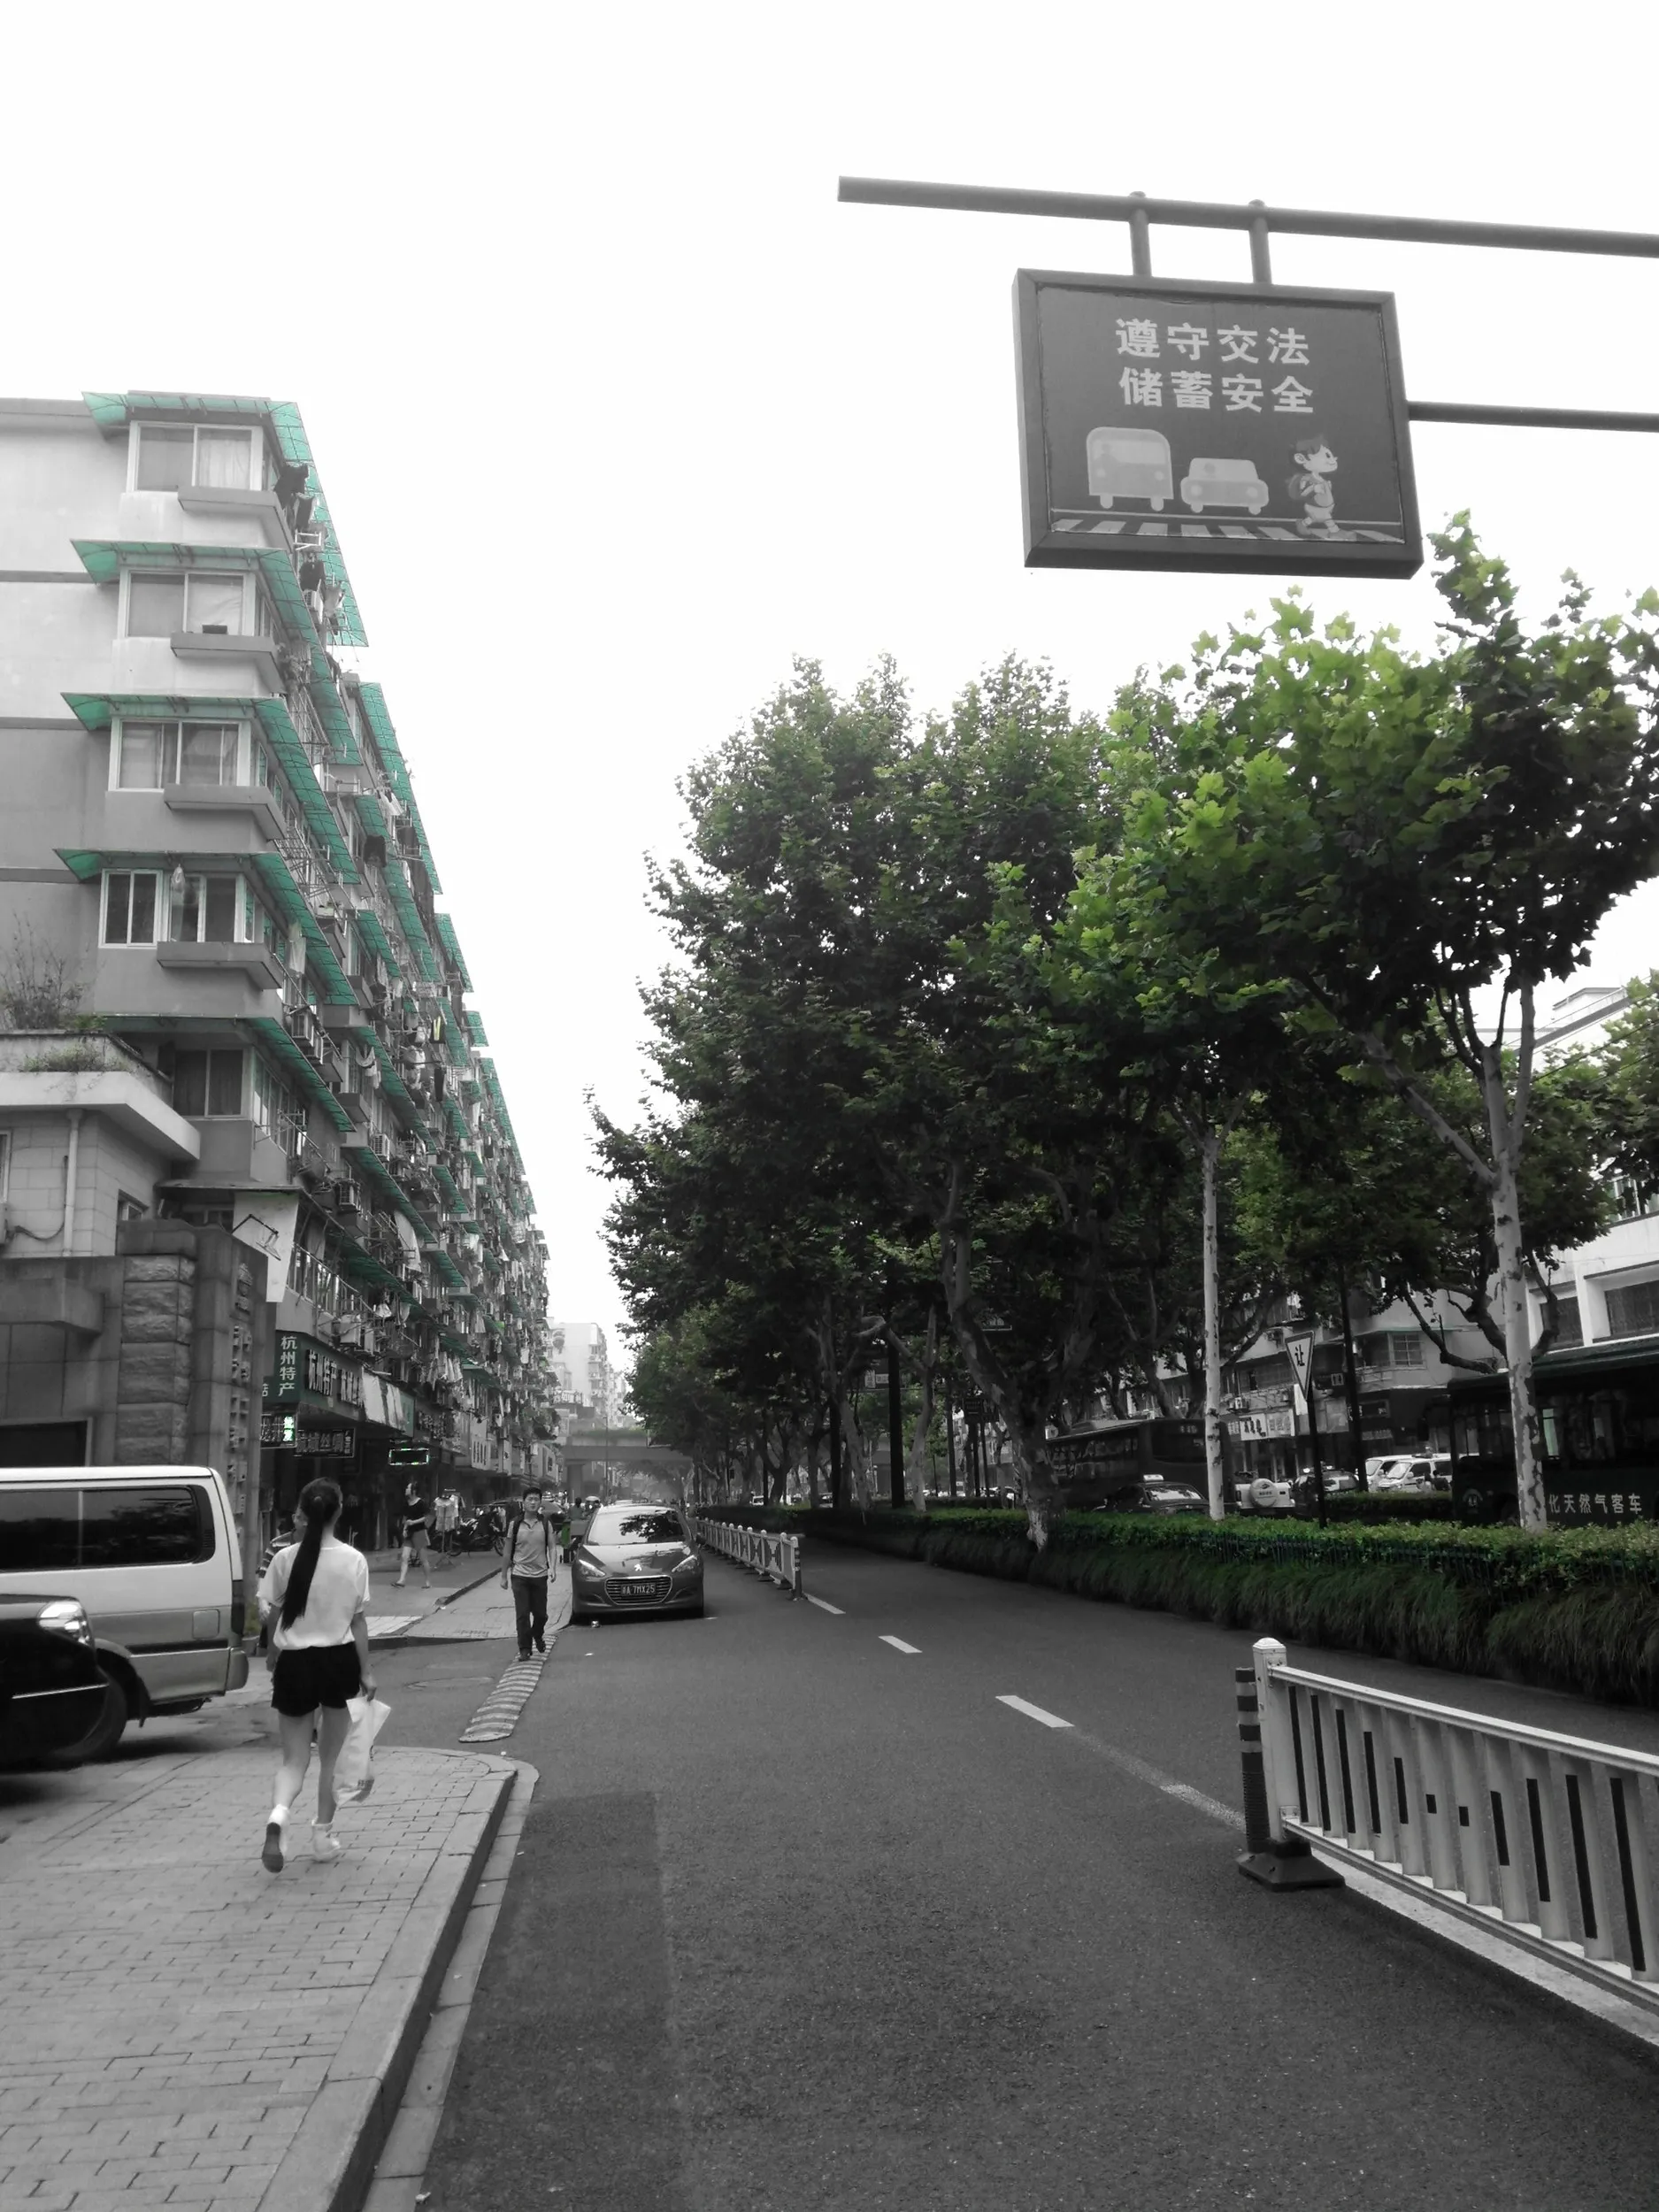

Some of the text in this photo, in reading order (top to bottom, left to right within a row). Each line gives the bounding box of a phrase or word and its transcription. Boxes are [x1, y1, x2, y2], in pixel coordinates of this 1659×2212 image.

[1115, 318, 1310, 365] 遵守交法
[1118, 366, 1315, 413] 储蓄安全
[278, 1335, 297, 1397] 杭州特产
[1294, 1343, 1305, 1366] 让
[1548, 1493, 1642, 1515] 化天然气客车
